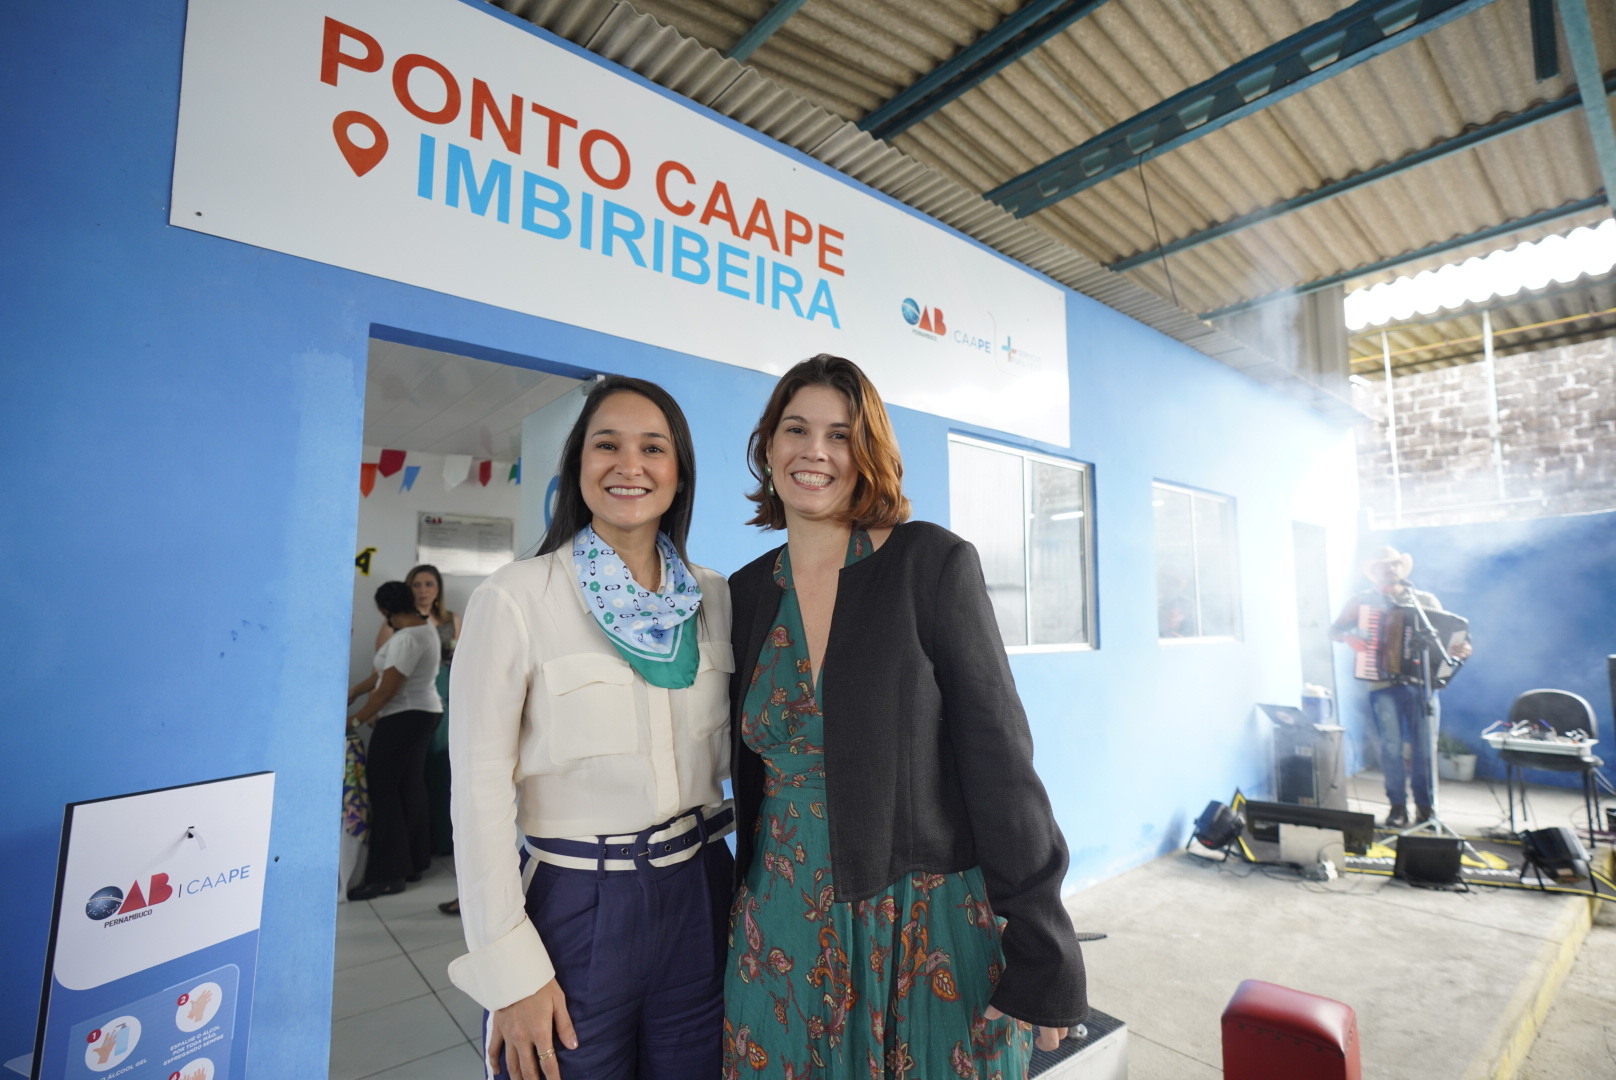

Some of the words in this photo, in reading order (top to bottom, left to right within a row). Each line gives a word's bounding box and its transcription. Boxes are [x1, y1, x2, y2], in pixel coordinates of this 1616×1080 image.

[320, 16, 632, 191] PONTO
[655, 160, 845, 277] CAAPE
[416, 132, 841, 330] IMBIRIBEIRA
[901, 297, 947, 336] OAB
[953, 329, 992, 354] CAAPE
[85, 872, 173, 921] OAB
[186, 864, 251, 895] CAAPE
[103, 908, 153, 929] PERNAMBUCO
[163, 1044, 203, 1066] ESFREGANDO
[203, 1033, 225, 1048] SEMPRE
[169, 1036, 196, 1051] ESPALME
[172, 1046, 185, 1056] POR
[186, 1039, 202, 1049] TODA
[135, 1059, 148, 1067] GEL
